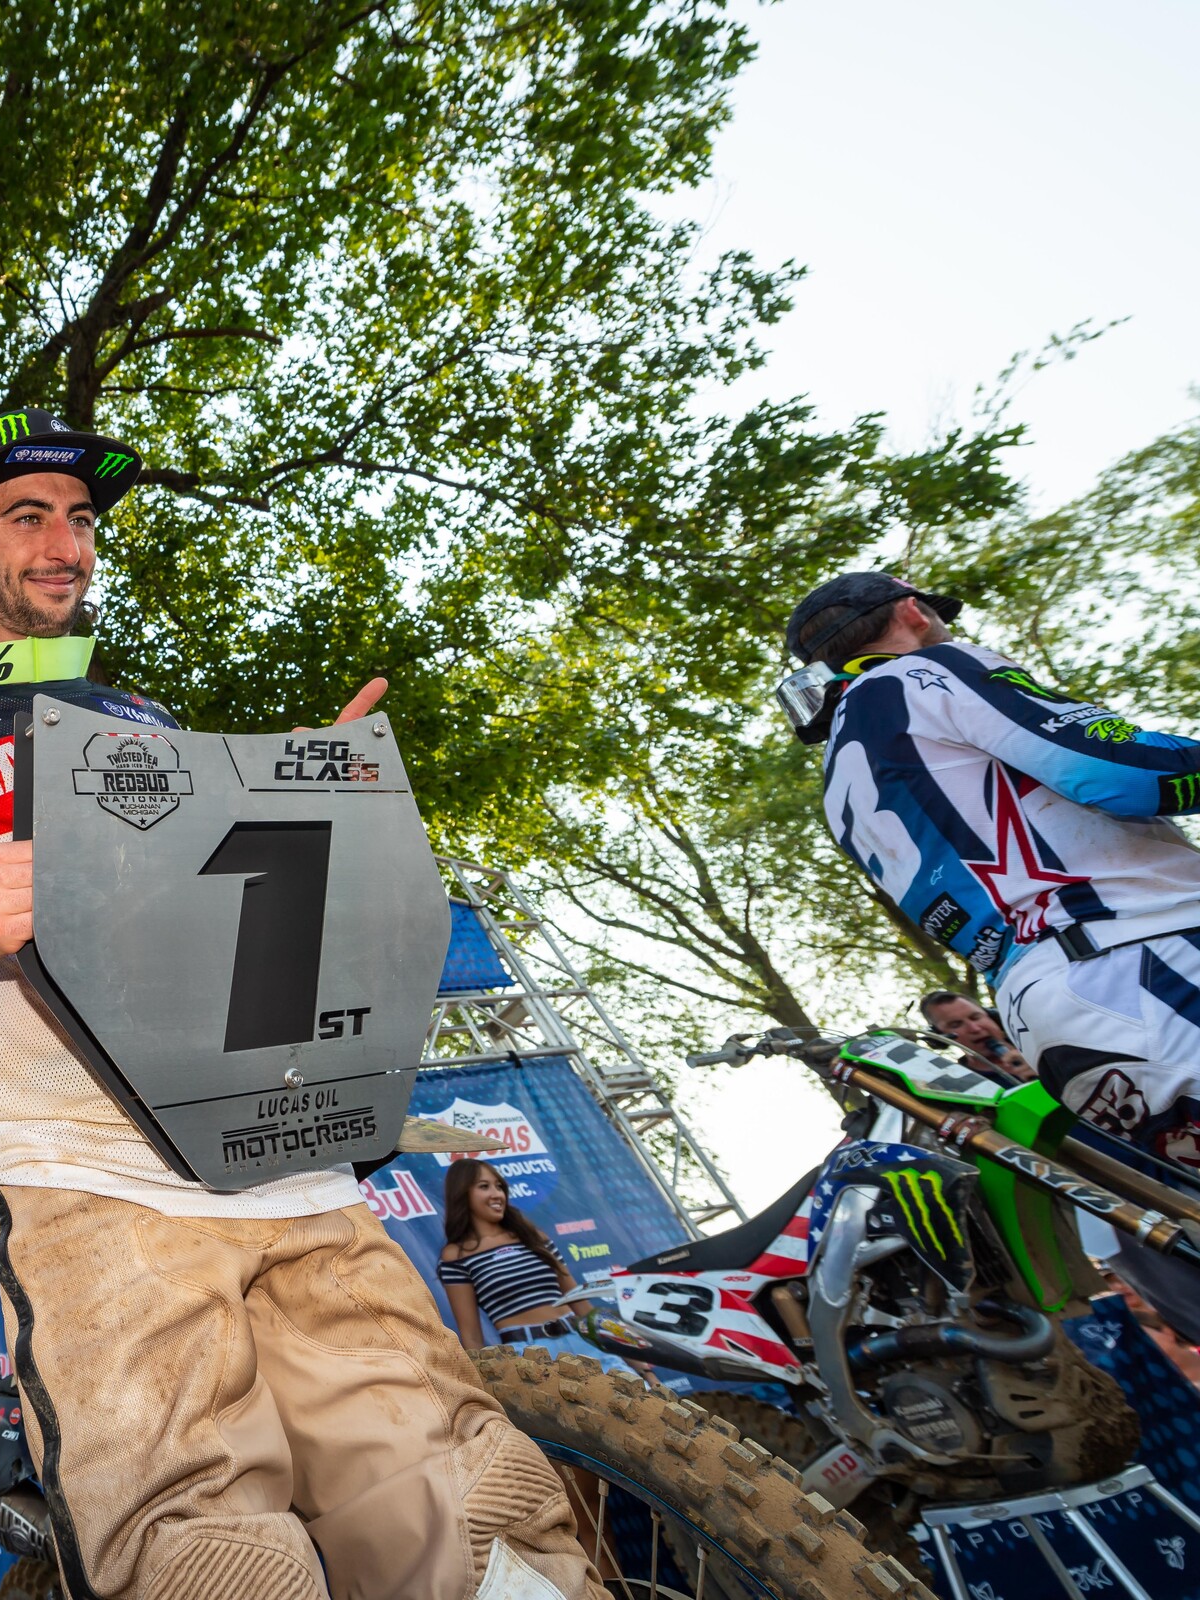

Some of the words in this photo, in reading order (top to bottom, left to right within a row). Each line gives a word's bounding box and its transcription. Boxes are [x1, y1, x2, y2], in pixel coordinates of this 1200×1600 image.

[29, 450, 76, 461] YAMAHA
[121, 704, 170, 729] YAM
[1040, 706, 1112, 733] Kawa
[106, 751, 142, 767] TWISTED
[143, 752, 159, 768] TEA
[102, 772, 170, 793] REDBUD
[273, 761, 380, 782] CLASS
[100, 795, 177, 803] NATIONAL
[196, 820, 334, 1053] 1
[317, 1006, 372, 1041] ST
[256, 1091, 312, 1120] LUCAS
[315, 1088, 340, 1110] OIL
[222, 1115, 377, 1164] MOTOCROSS
[495, 1159, 557, 1178] ODUCTS
[832, 1143, 890, 1173] KX
[508, 1182, 537, 1199] NC.
[579, 1243, 611, 1259] THOR
[723, 1275, 752, 1283] 450
[633, 1281, 714, 1337] 3
[821, 1452, 857, 1486] DID
